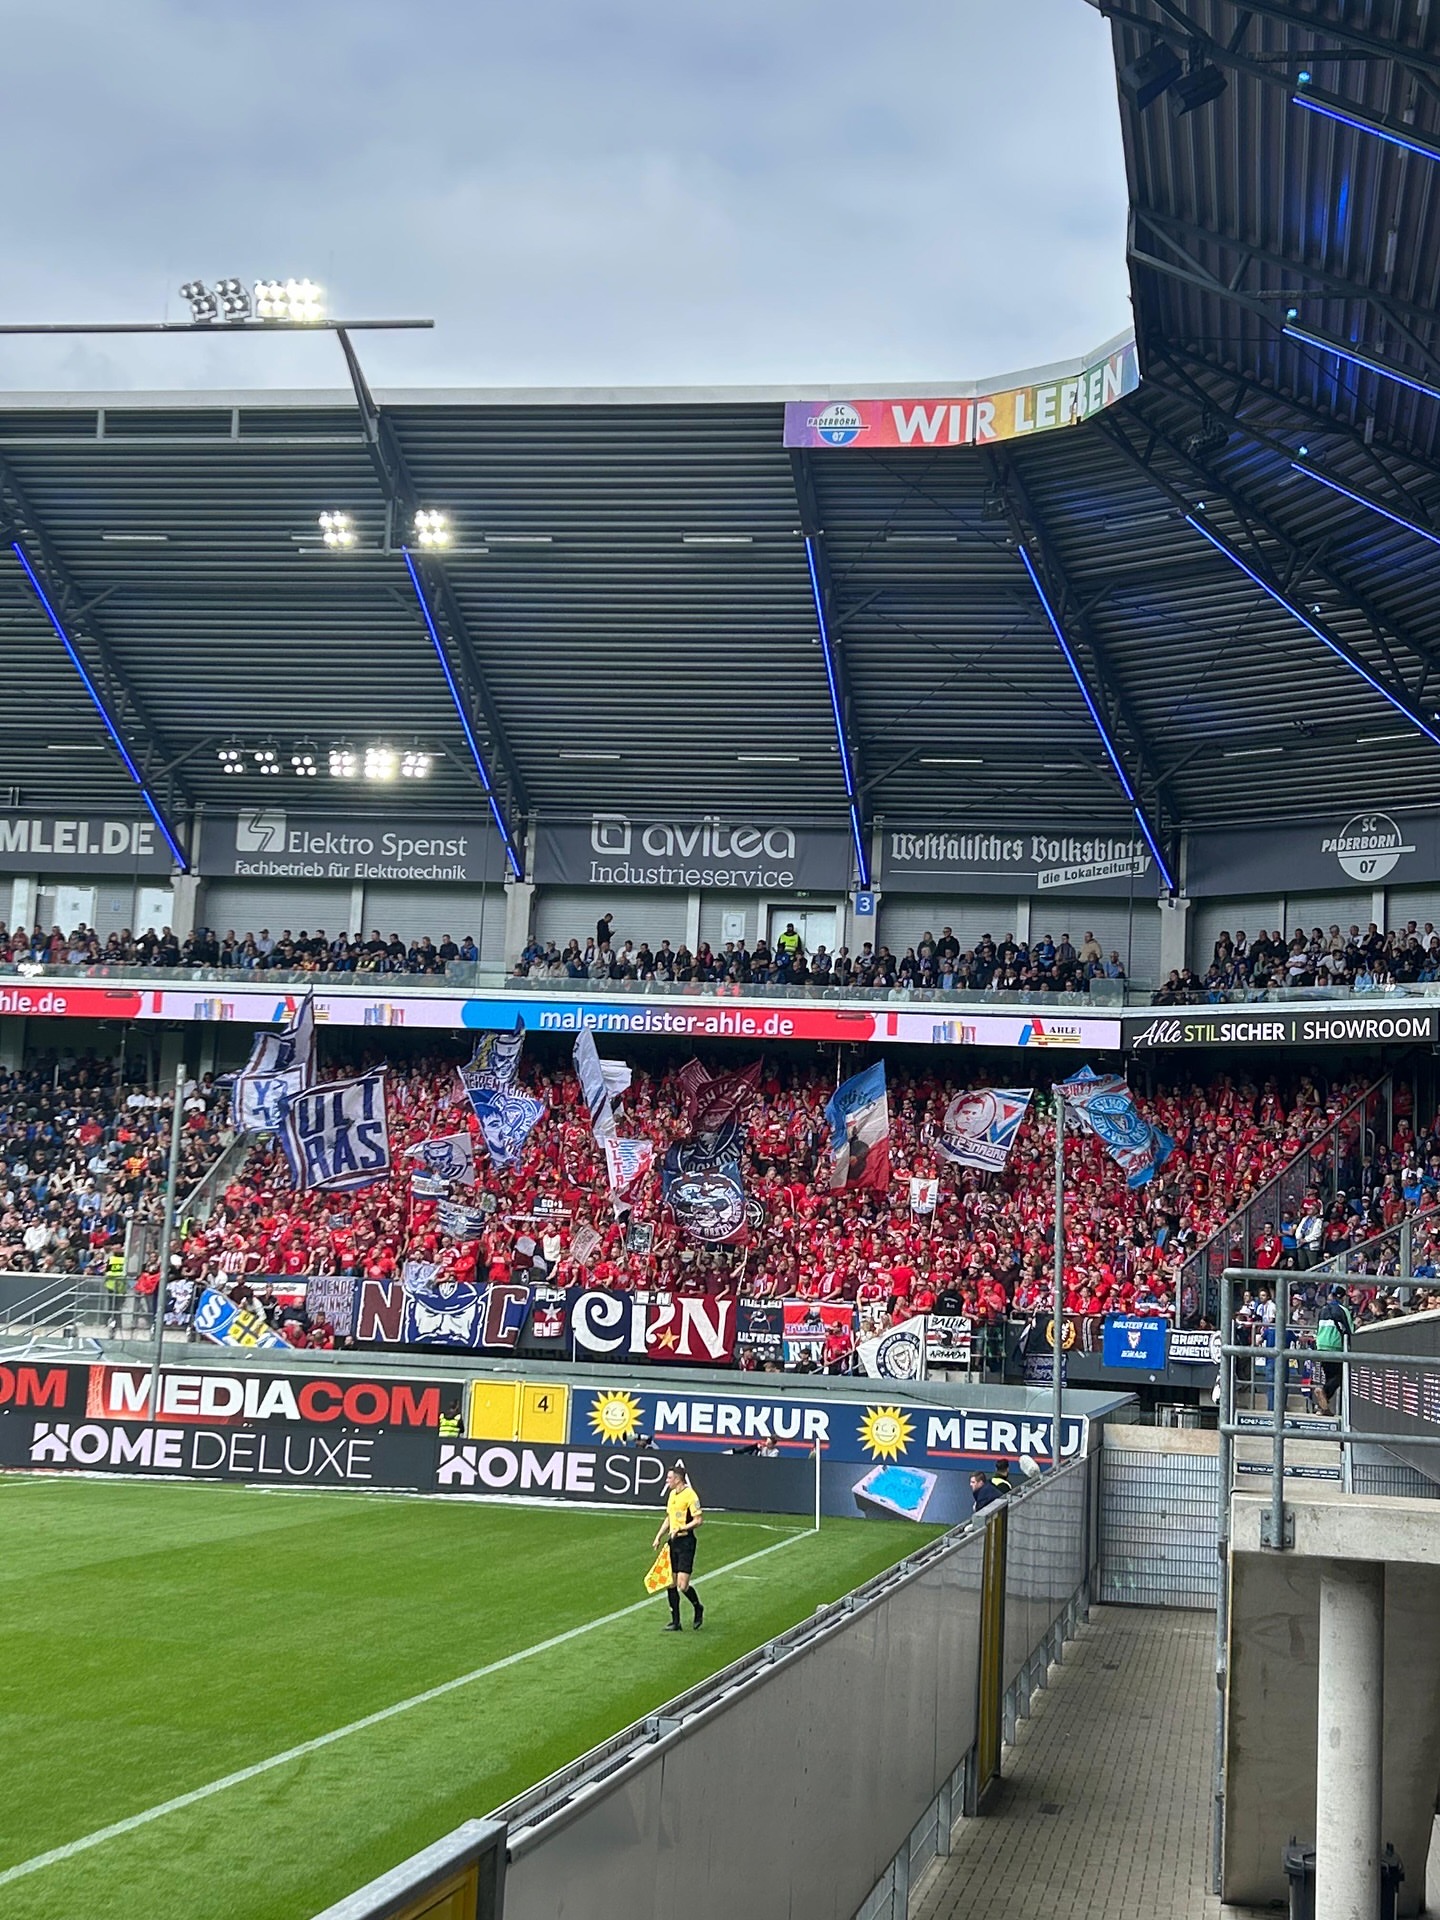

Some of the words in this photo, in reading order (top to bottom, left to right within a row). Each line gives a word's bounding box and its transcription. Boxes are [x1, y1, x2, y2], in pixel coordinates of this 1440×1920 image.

[891, 404, 997, 443] WIR
[1014, 352, 1124, 433] LEBEN
[808, 418, 857, 426] PADERBORN
[834, 406, 846, 416] SC
[831, 431, 846, 442] 07
[642, 815, 796, 859] avitea
[1361, 817, 1377, 833] SC
[288, 831, 374, 855] Elektro
[381, 832, 468, 862] Spenst
[1321, 834, 1396, 853] PADERBORN
[235, 859, 324, 878] Fachbetrieb
[328, 862, 350, 878] für
[354, 862, 467, 880] Elektrotechnik
[589, 861, 794, 887] Industrieservice
[1042, 871, 1061, 885] die
[1064, 860, 1140, 881] Lokalzeitung
[1359, 860, 1377, 874] 07
[859, 896, 871, 912] 3
[539, 1007, 794, 1037] malermeister-ahle.de
[1132, 1020, 1183, 1048] Ahle
[1302, 1017, 1432, 1043] SHOWROOM
[737, 1331, 781, 1344] ULTRAS
[109, 1371, 441, 1428] MEDIACOM
[536, 1393, 550, 1412] 4
[653, 1399, 830, 1442] MERKUR
[29, 1421, 184, 1468] HOME
[191, 1430, 375, 1479] DELUXE
[436, 1444, 597, 1493] HOME
